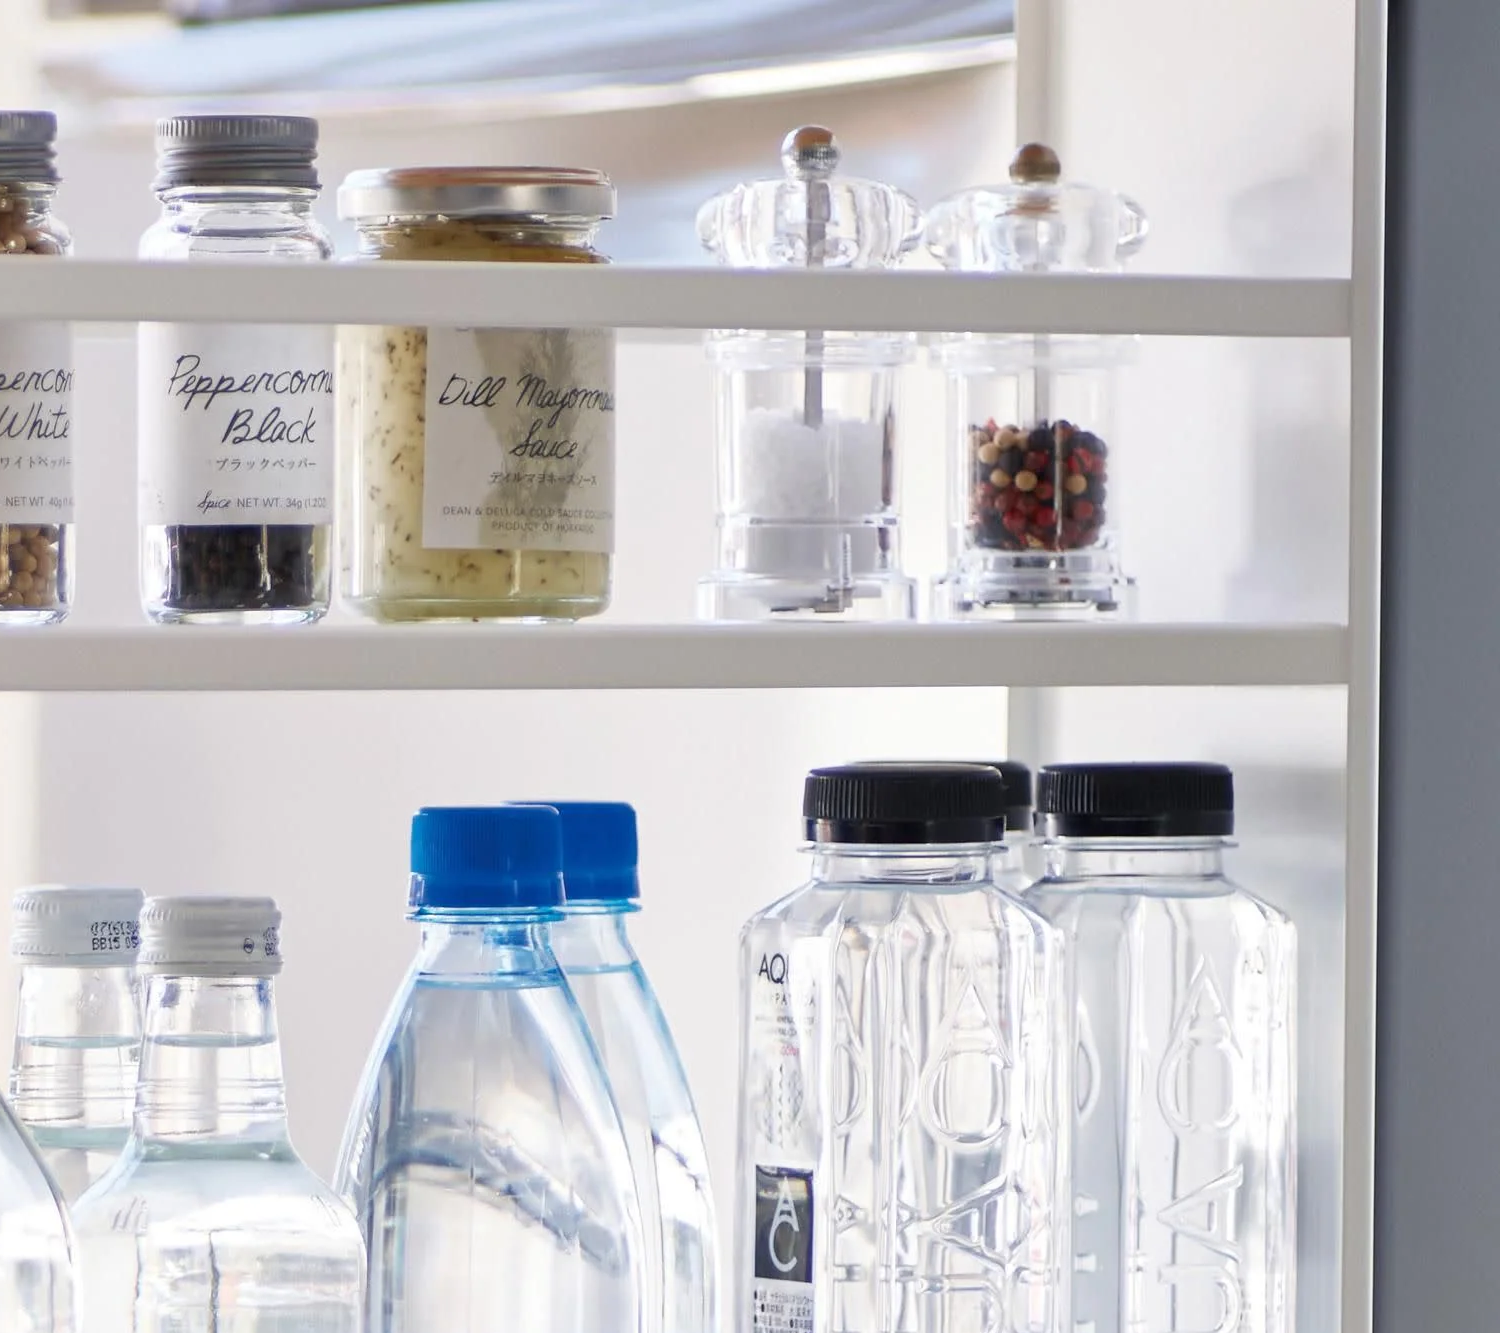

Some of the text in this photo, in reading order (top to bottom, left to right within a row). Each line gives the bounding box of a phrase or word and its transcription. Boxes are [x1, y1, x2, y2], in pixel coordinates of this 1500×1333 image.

[438, 373, 507, 408] Dill
[221, 406, 317, 445] Black
[509, 418, 578, 459] Sauce
[5, 496, 27, 507] NET
[197, 489, 232, 515] Spice
[236, 497, 259, 508] NET
[442, 505, 472, 516] DEAN
